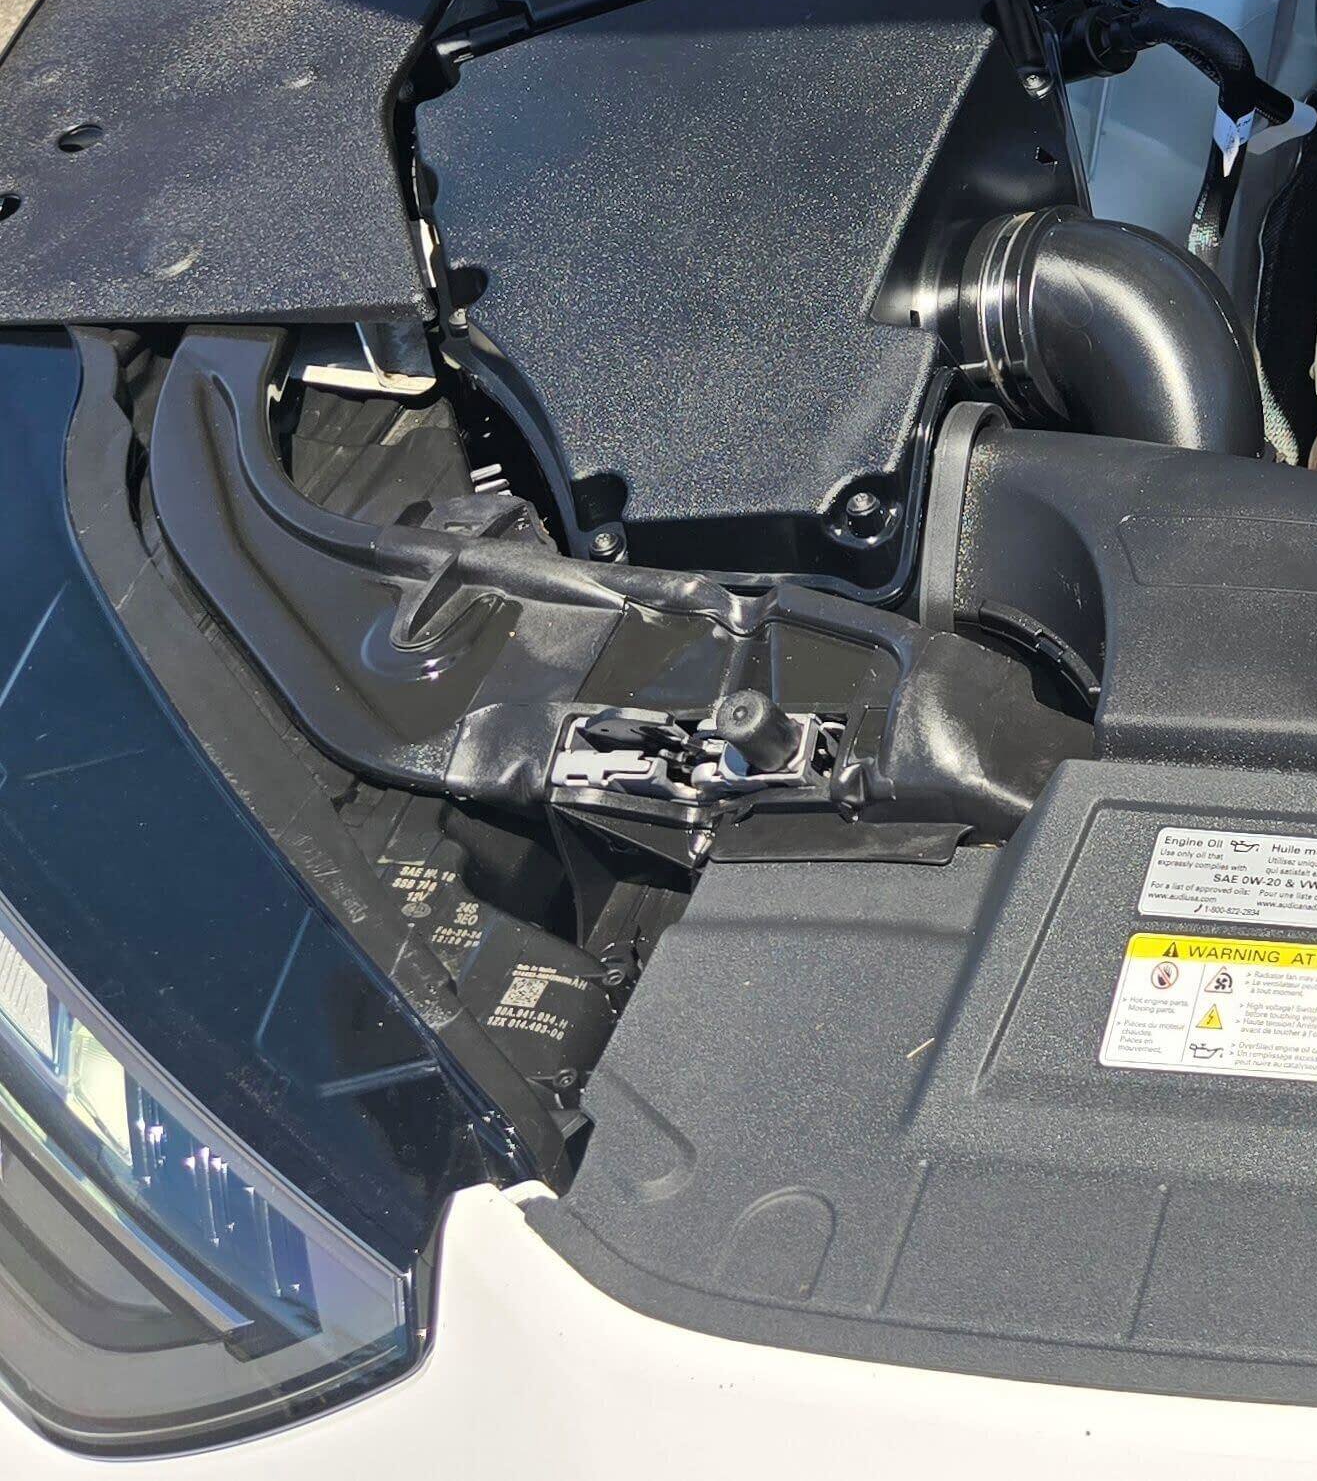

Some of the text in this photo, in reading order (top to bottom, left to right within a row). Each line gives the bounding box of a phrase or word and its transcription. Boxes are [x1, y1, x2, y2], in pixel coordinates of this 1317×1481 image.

[1164, 835, 1224, 849] Engine Oil
[1177, 849, 1193, 858] only
[1208, 852, 1224, 860] that
[1272, 843, 1300, 855] Huile
[1158, 859, 1192, 869] expressly
[1194, 861, 1228, 871] complies
[1268, 857, 1295, 865] Utilisez
[400, 865, 422, 879] SAE
[1266, 867, 1310, 877] qui satisfait
[1212, 873, 1239, 883] SAE
[1242, 876, 1282, 886] 0W-20
[1285, 879, 1295, 888] &
[1150, 881, 1164, 889] For
[1186, 883, 1194, 891] of
[1195, 885, 1232, 895] approved
[406, 891, 428, 903] 12V
[1148, 893, 1217, 903] www.audiusa.com
[1259, 889, 1278, 897] Pour
[1278, 891, 1294, 899] une
[1296, 893, 1312, 901] liste
[456, 901, 480, 915] 24S
[1188, 945, 1280, 963] WARNING
[572, 975, 588, 991] AH
[1128, 1003, 1154, 1013] Moving
[1130, 997, 1143, 1005] Hot
[1144, 998, 1168, 1007] engine
[1246, 1001, 1264, 1011] High
[1270, 1012, 1300, 1021] touching
[1274, 1029, 1300, 1037] toucher
[1238, 1041, 1274, 1051] Overfilled
[1274, 1045, 1300, 1053] engine
